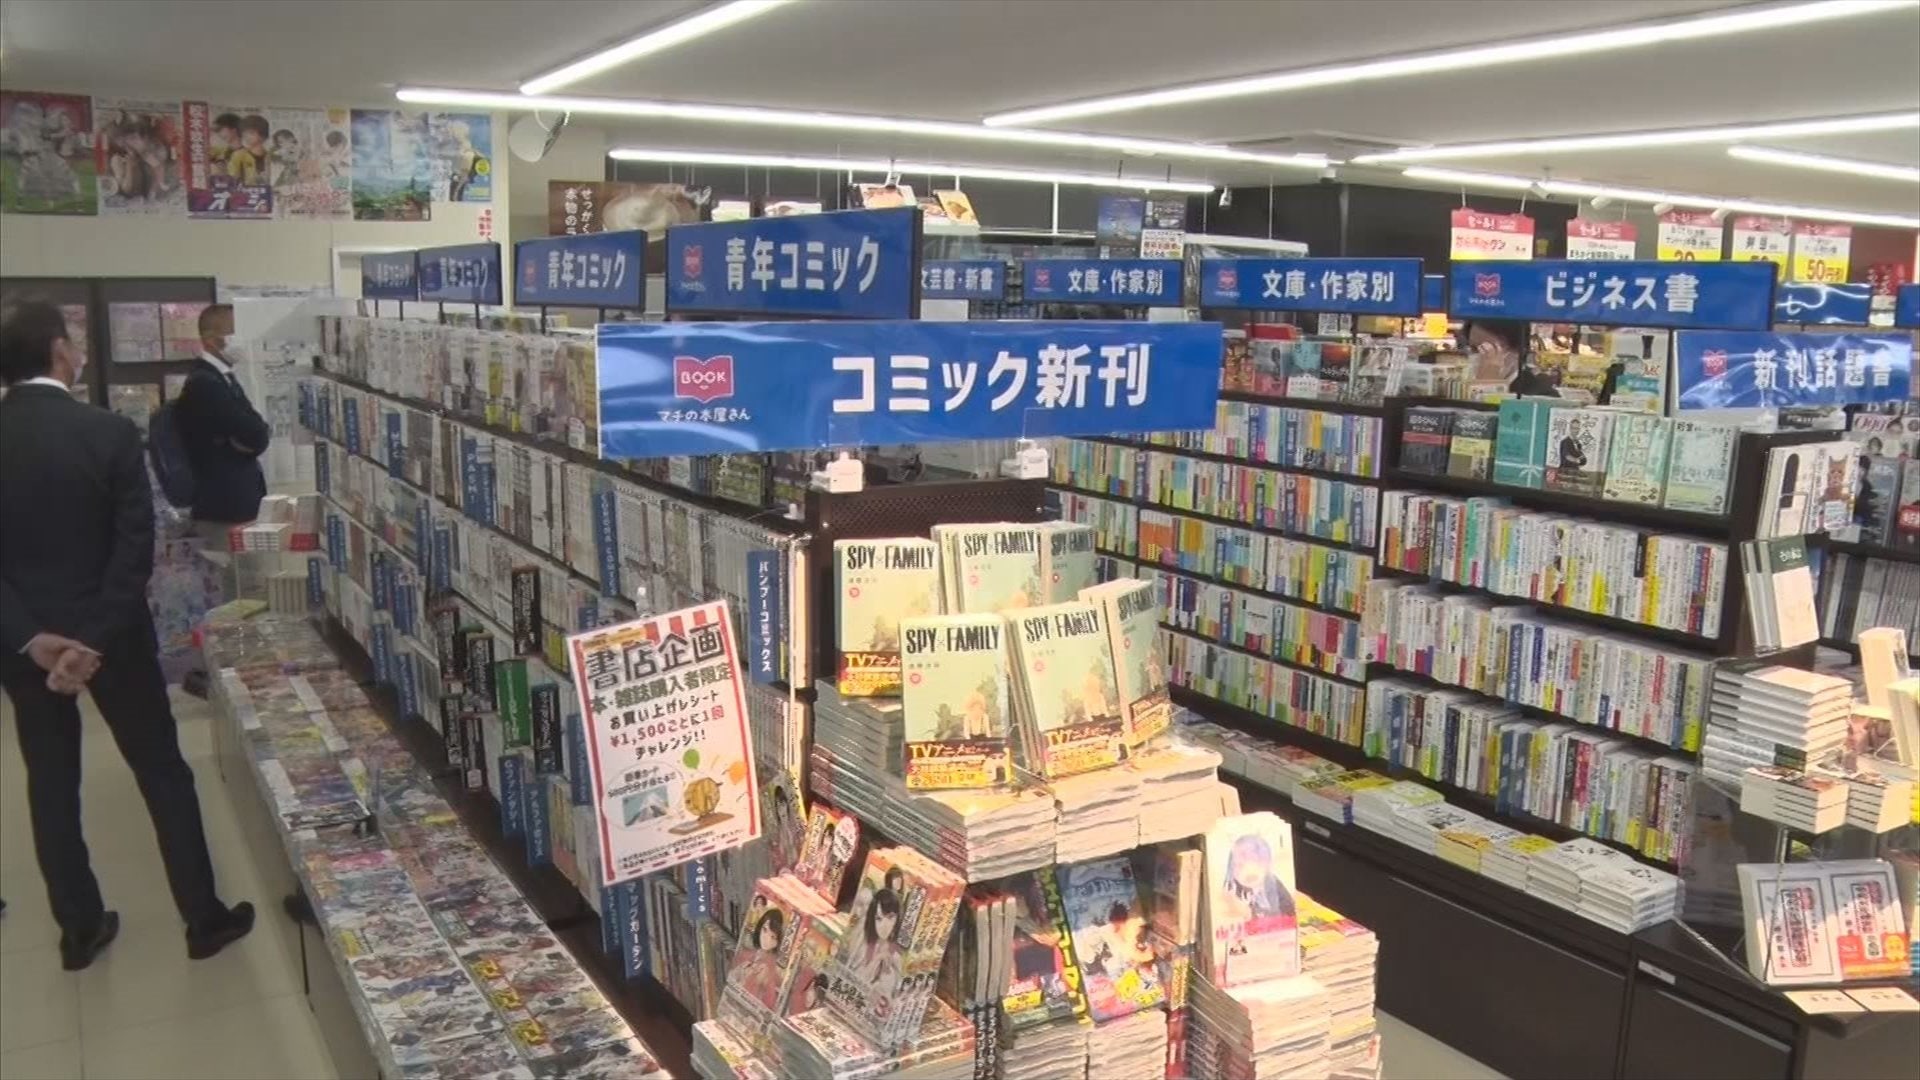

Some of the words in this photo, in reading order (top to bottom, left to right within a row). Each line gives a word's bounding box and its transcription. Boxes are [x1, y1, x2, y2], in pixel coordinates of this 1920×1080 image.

[439, 255, 489, 293] 青年コミック
[548, 250, 626, 290] 青年コミック
[725, 235, 880, 294] 青年コミック
[1068, 269, 1163, 294] 文庫・作家別
[1262, 269, 1394, 302] 文庫・作家別
[1546, 271, 1700, 313] ビジネス書
[680, 371, 727, 384] BOOK
[831, 343, 1150, 413] コミック新刊
[1753, 347, 1892, 389] 新刊話題書
[657, 407, 752, 423] マチの本屋さん
[585, 621, 726, 690] 書店企画
[592, 662, 731, 716] 本・雑誌購入者限定
[610, 690, 719, 731] お買い上げレシート
